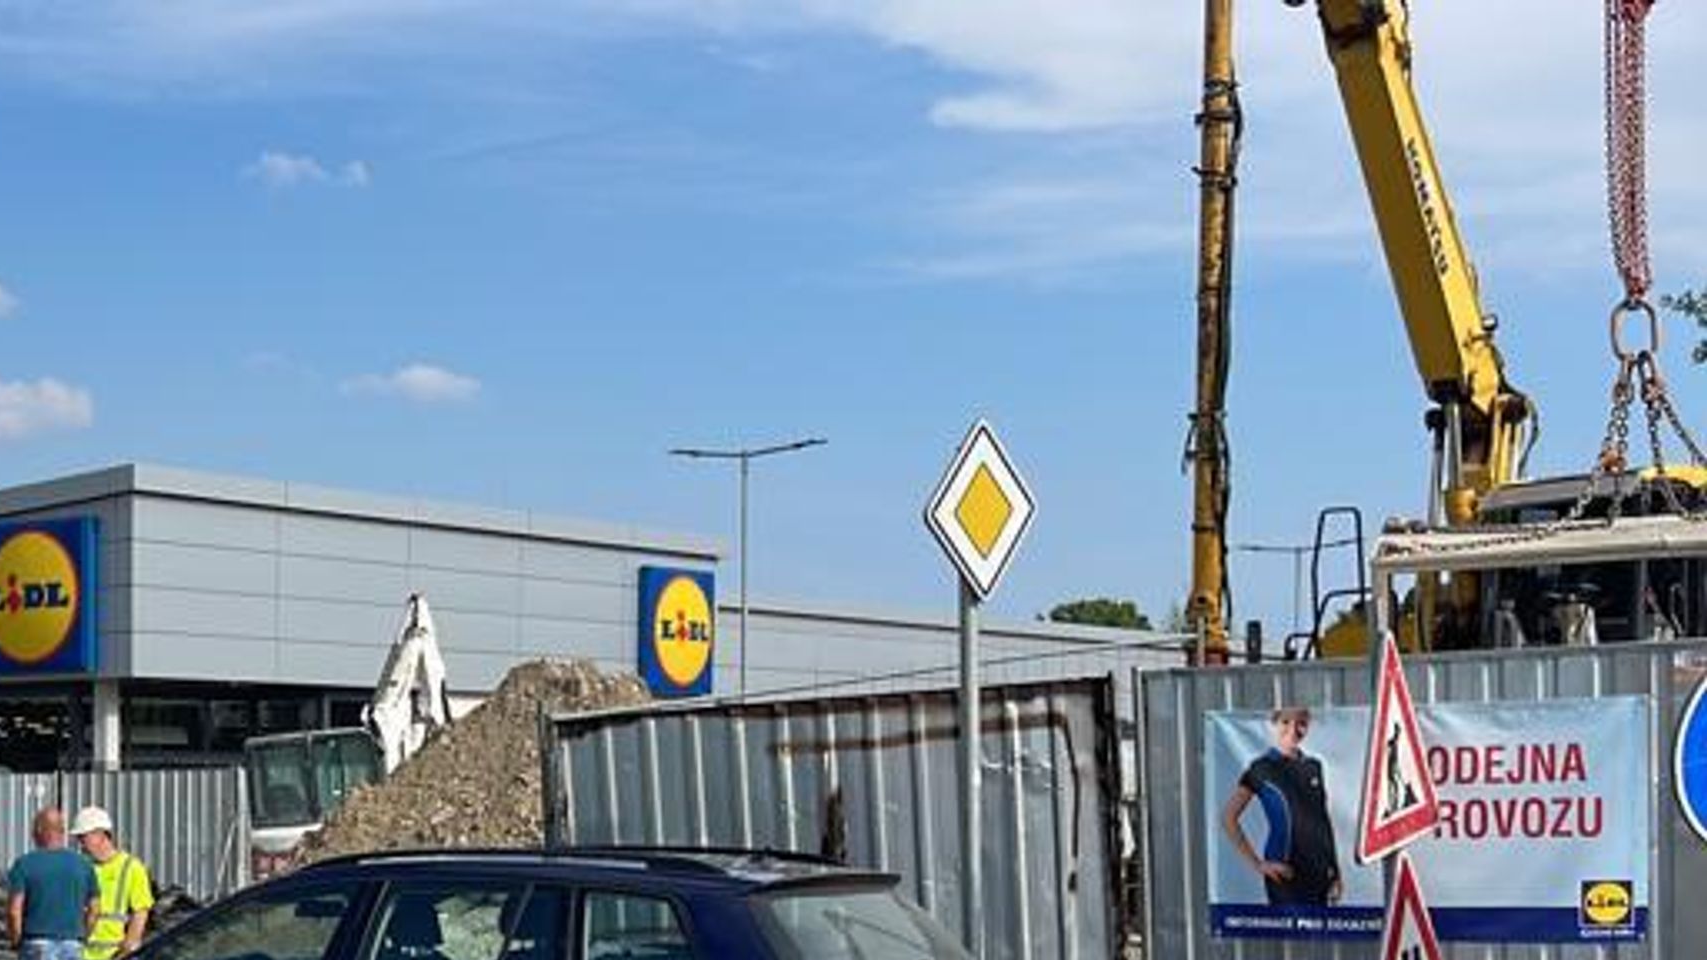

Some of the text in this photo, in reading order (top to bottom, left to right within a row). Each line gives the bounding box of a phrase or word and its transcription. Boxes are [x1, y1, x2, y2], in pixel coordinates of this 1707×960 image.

[660, 608, 709, 642] LIDL
[1427, 743, 1586, 785] ODEJNA
[1435, 797, 1602, 839] ROVOZU
